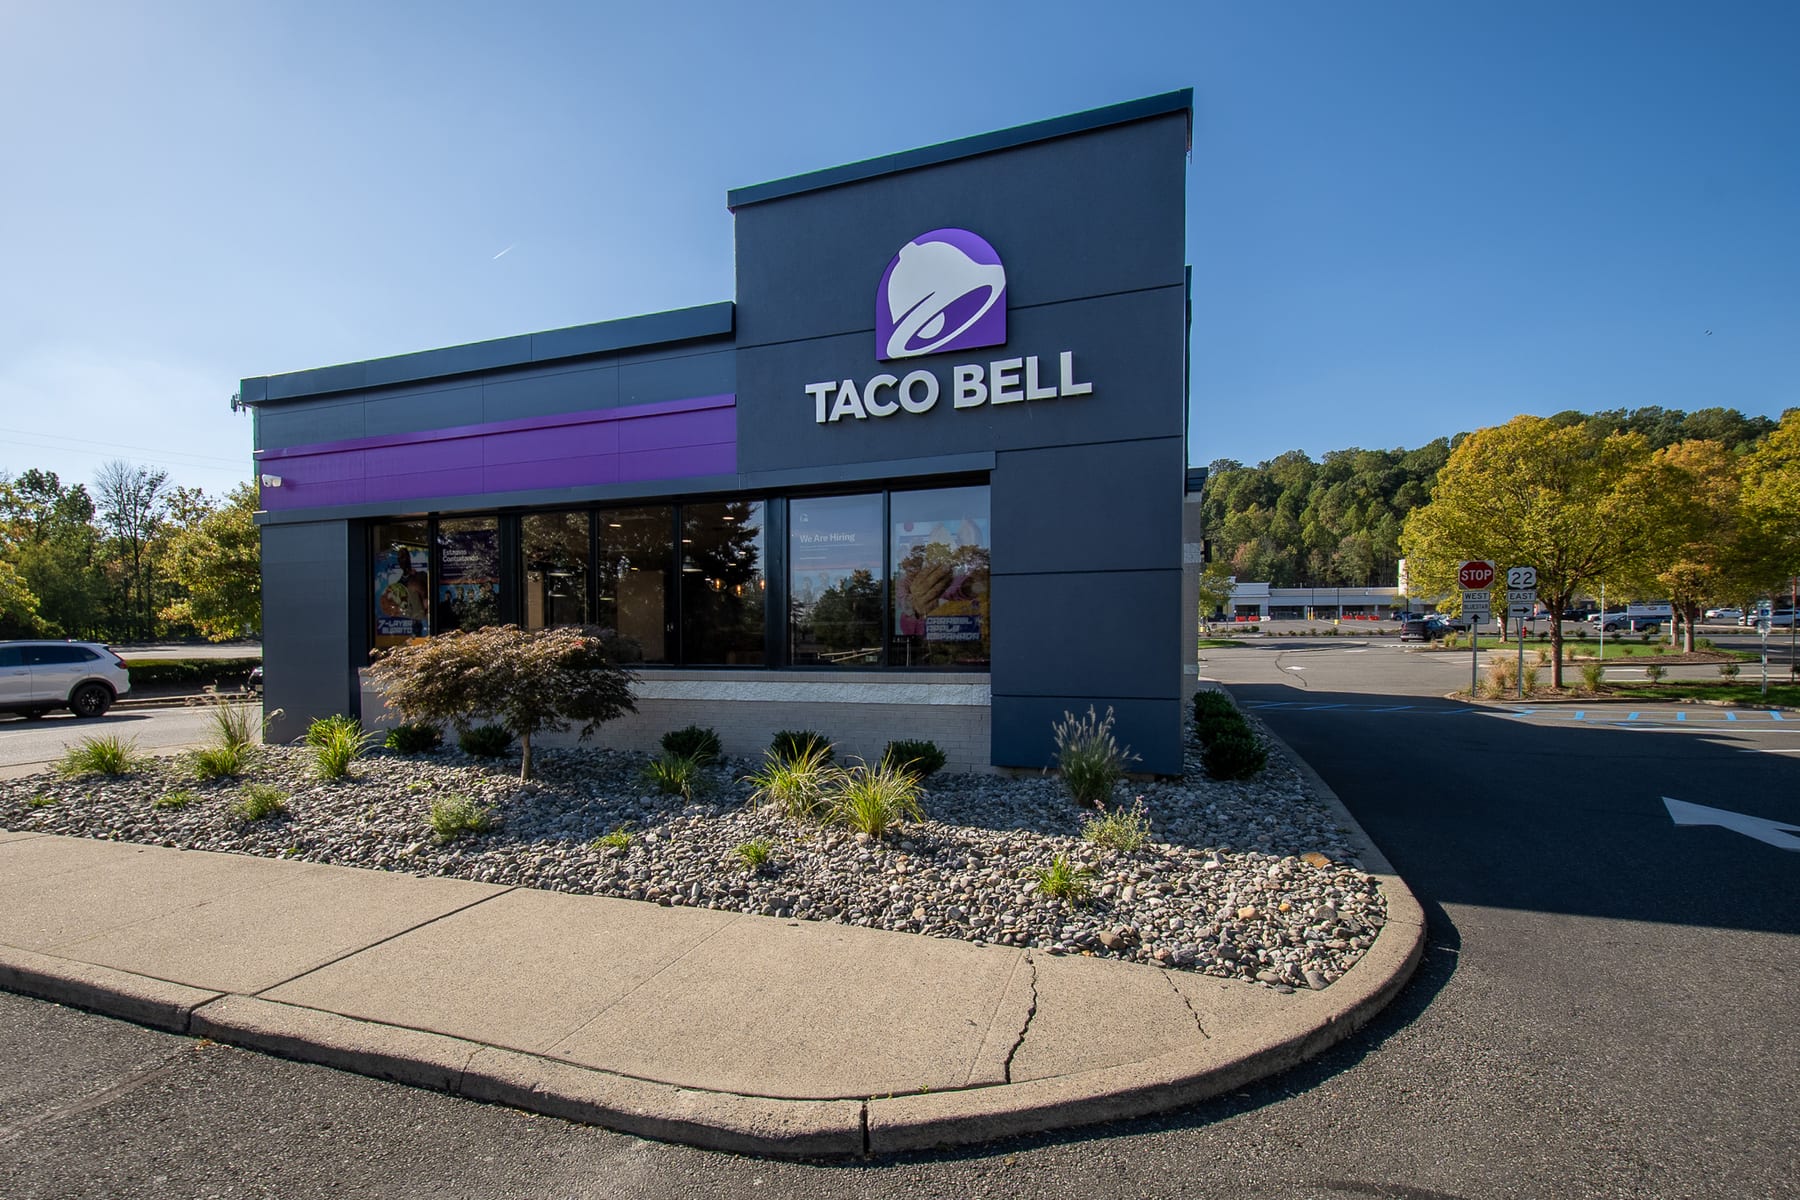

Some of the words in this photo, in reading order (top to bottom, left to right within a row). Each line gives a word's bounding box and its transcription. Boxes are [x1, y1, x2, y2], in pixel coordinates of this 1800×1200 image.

[805, 370, 940, 423] TACO
[953, 351, 1092, 408] BELL
[800, 535, 813, 543] We
[814, 534, 828, 542] Are
[830, 533, 855, 543] Hiring
[1461, 569, 1492, 581] STOP
[1512, 571, 1533, 584] 22
[378, 619, 412, 629] 7-LAYER
